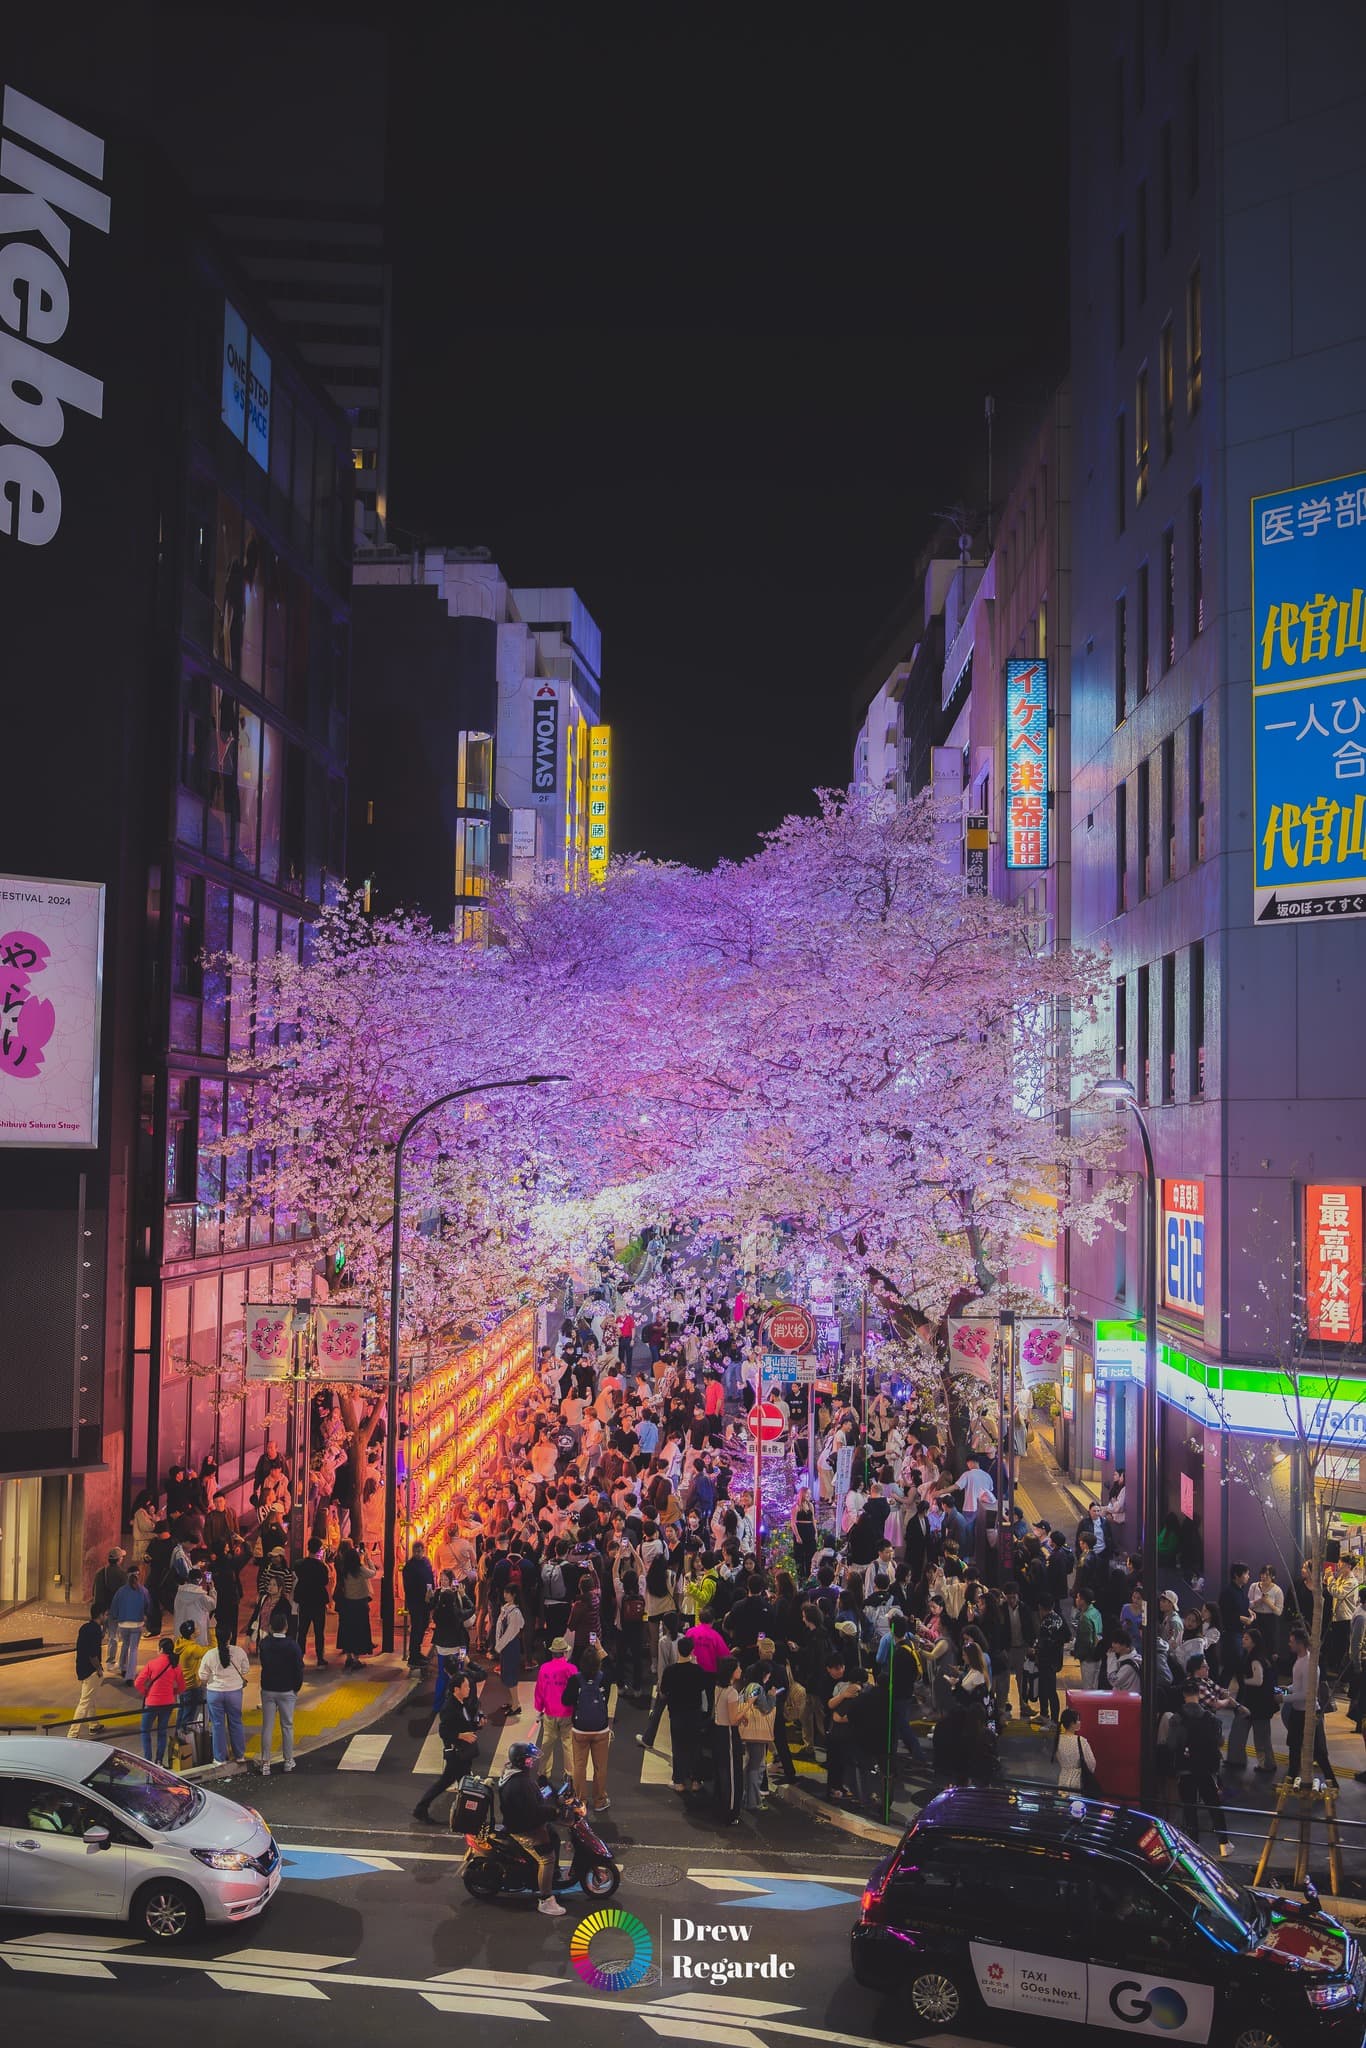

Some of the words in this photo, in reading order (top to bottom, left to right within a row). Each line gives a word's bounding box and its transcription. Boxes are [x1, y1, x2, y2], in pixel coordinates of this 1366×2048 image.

[0, 85, 111, 546] Ikebe
[227, 344, 247, 385] ONE
[249, 368, 269, 408] STEP
[239, 389, 267, 438] SPACE
[1261, 488, 1366, 547] 医学部
[536, 706, 555, 788] TOMAS
[1010, 665, 1044, 828] イケベ楽器
[538, 795, 550, 803] 2F
[591, 801, 605, 860] 伊藤塾
[969, 819, 985, 828] 1F
[1020, 832, 1035, 842] 7F
[1020, 843, 1035, 853] 6F
[1020, 854, 1035, 865] 5F
[47, 895, 71, 906] 2024
[29, 1120, 56, 1129] Sakura
[57, 1121, 81, 1131] Stage
[1168, 1216, 1205, 1307] ena
[1318, 1193, 1351, 1334] 最高水準
[773, 1323, 805, 1338] 消火栓
[748, 1444, 782, 1454] 自車を除く
[1020, 1970, 1047, 1982] TAXI
[1020, 1982, 1050, 1995] GOes
[1052, 1987, 1081, 2001] Next.
